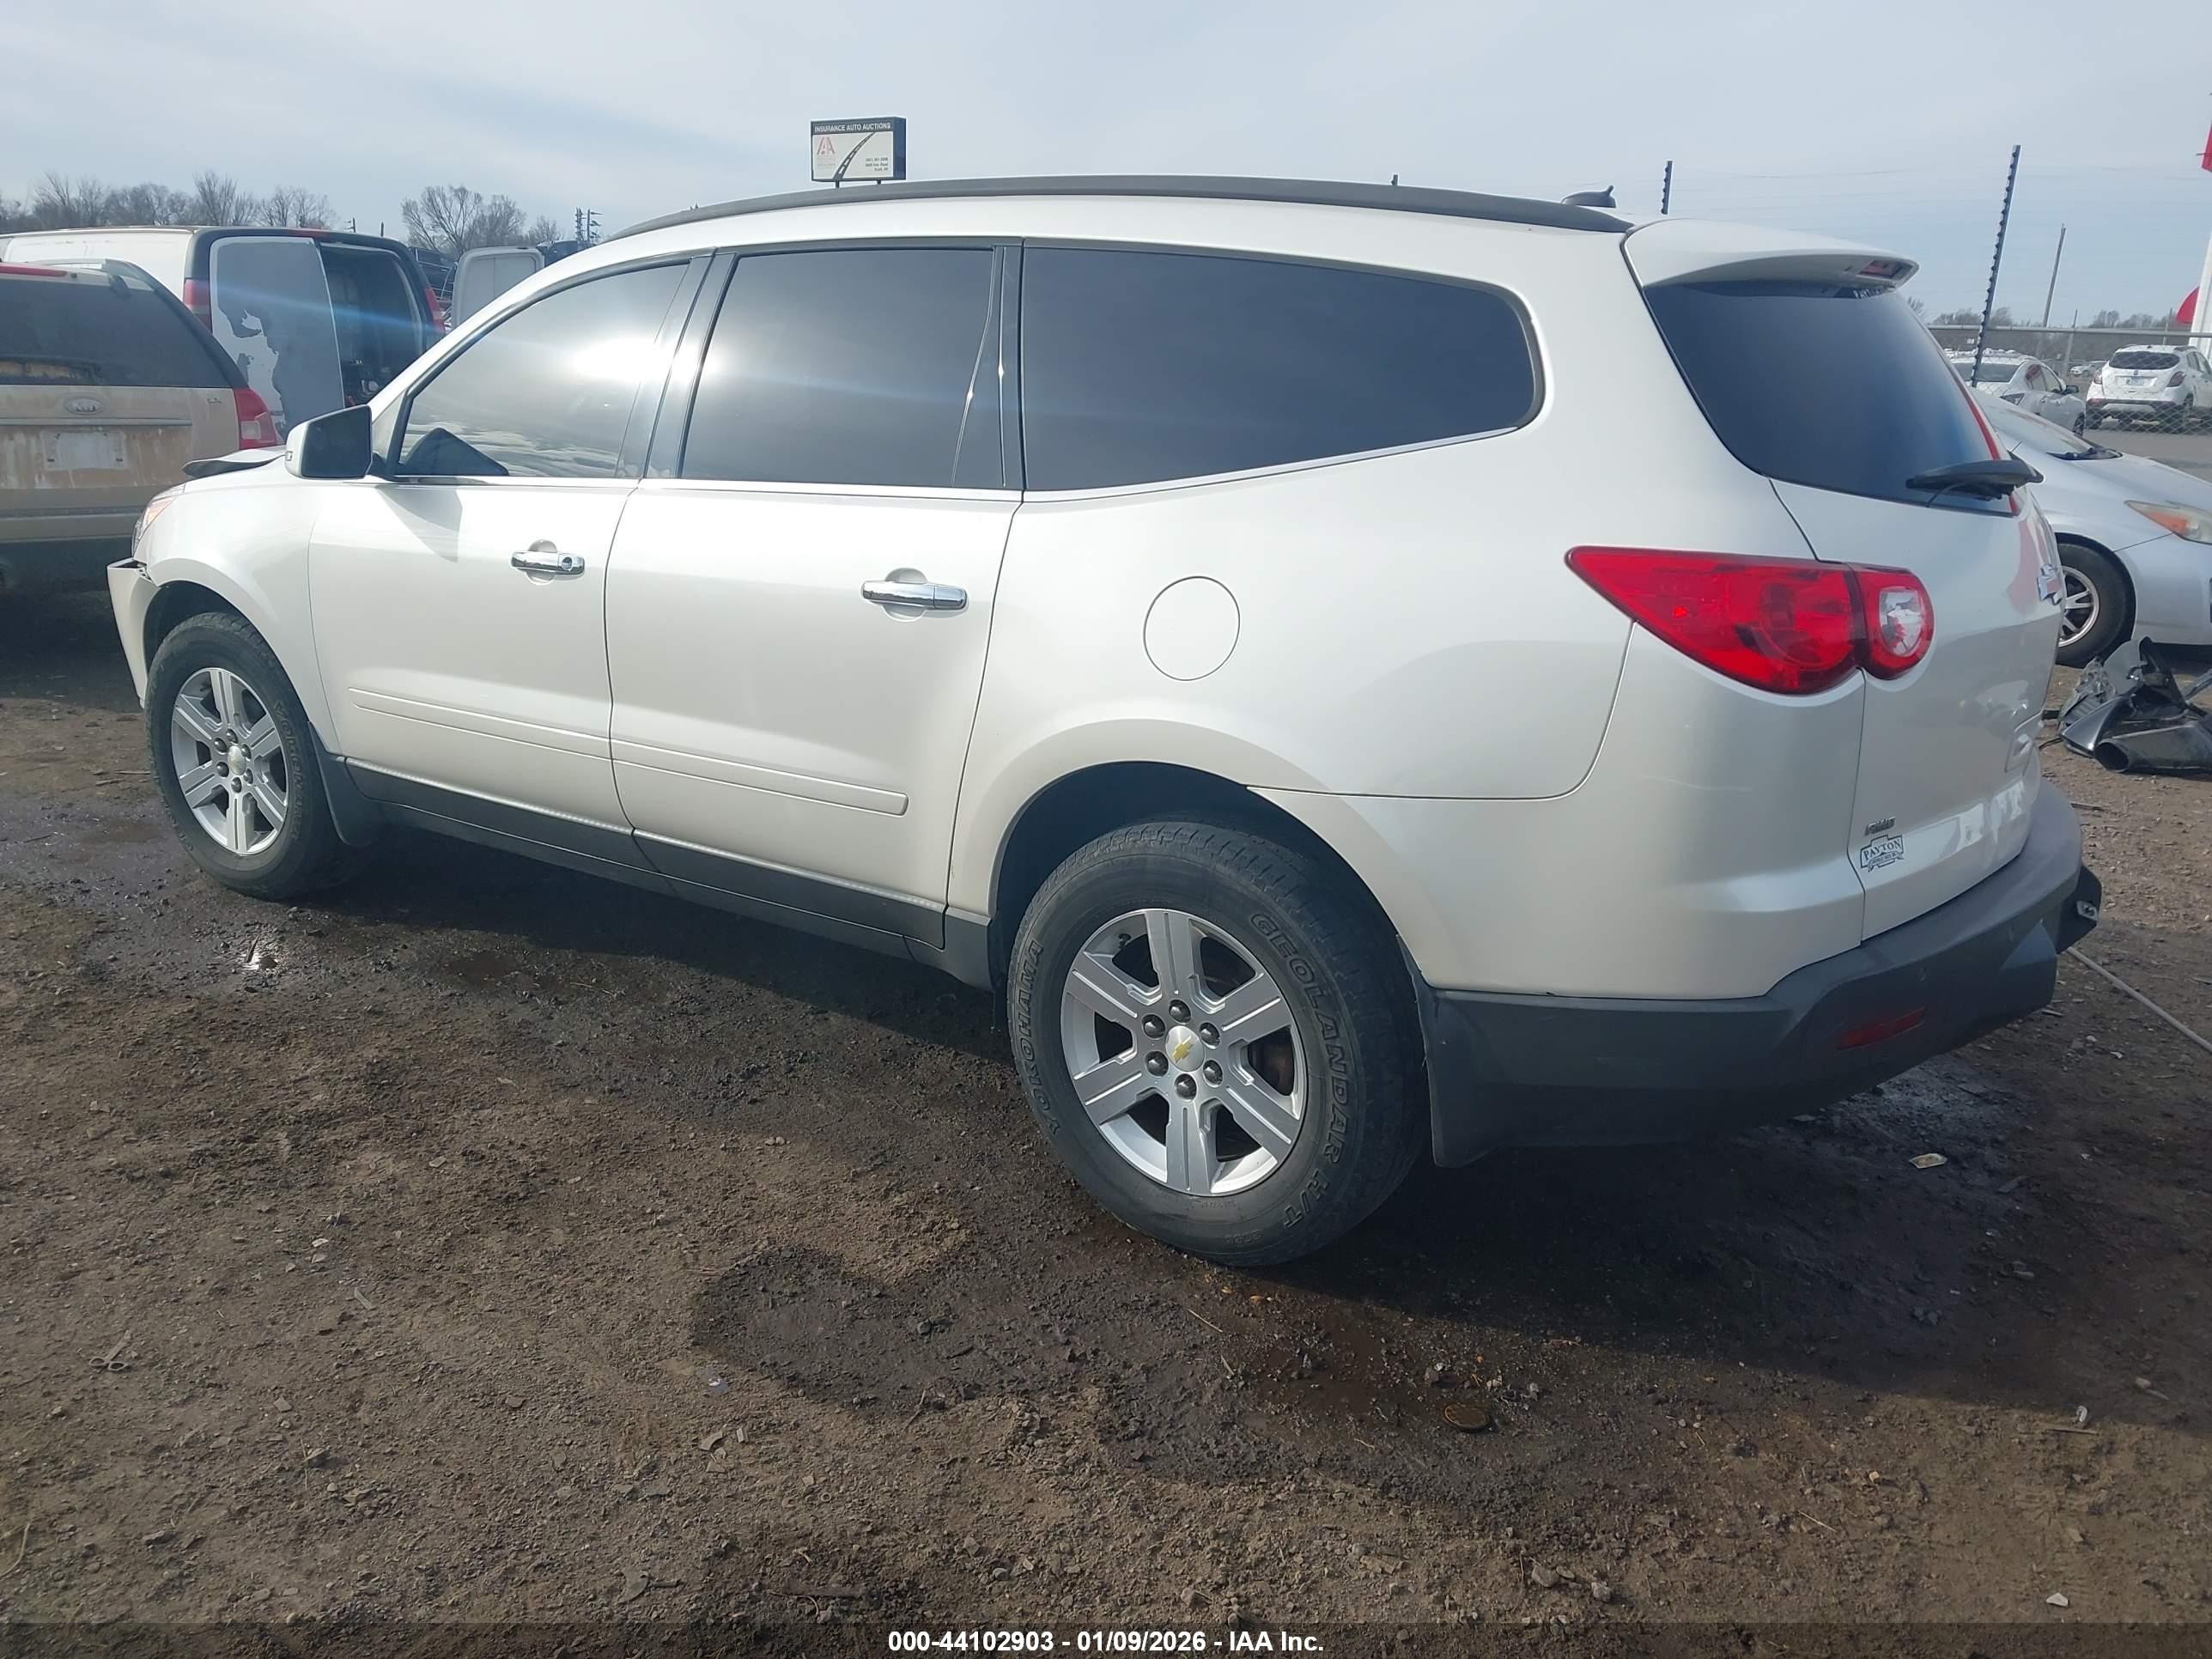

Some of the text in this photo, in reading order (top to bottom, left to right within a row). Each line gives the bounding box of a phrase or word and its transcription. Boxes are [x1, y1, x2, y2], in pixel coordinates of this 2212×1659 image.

[814, 125, 846, 133] INSURANCE
[862, 122, 891, 131] AUCTIONS
[1863, 838, 1903, 860] PAYTON
[1014, 939, 1062, 1136] YOKOHAMA
[1249, 912, 1350, 1164] GEOLANDAR
